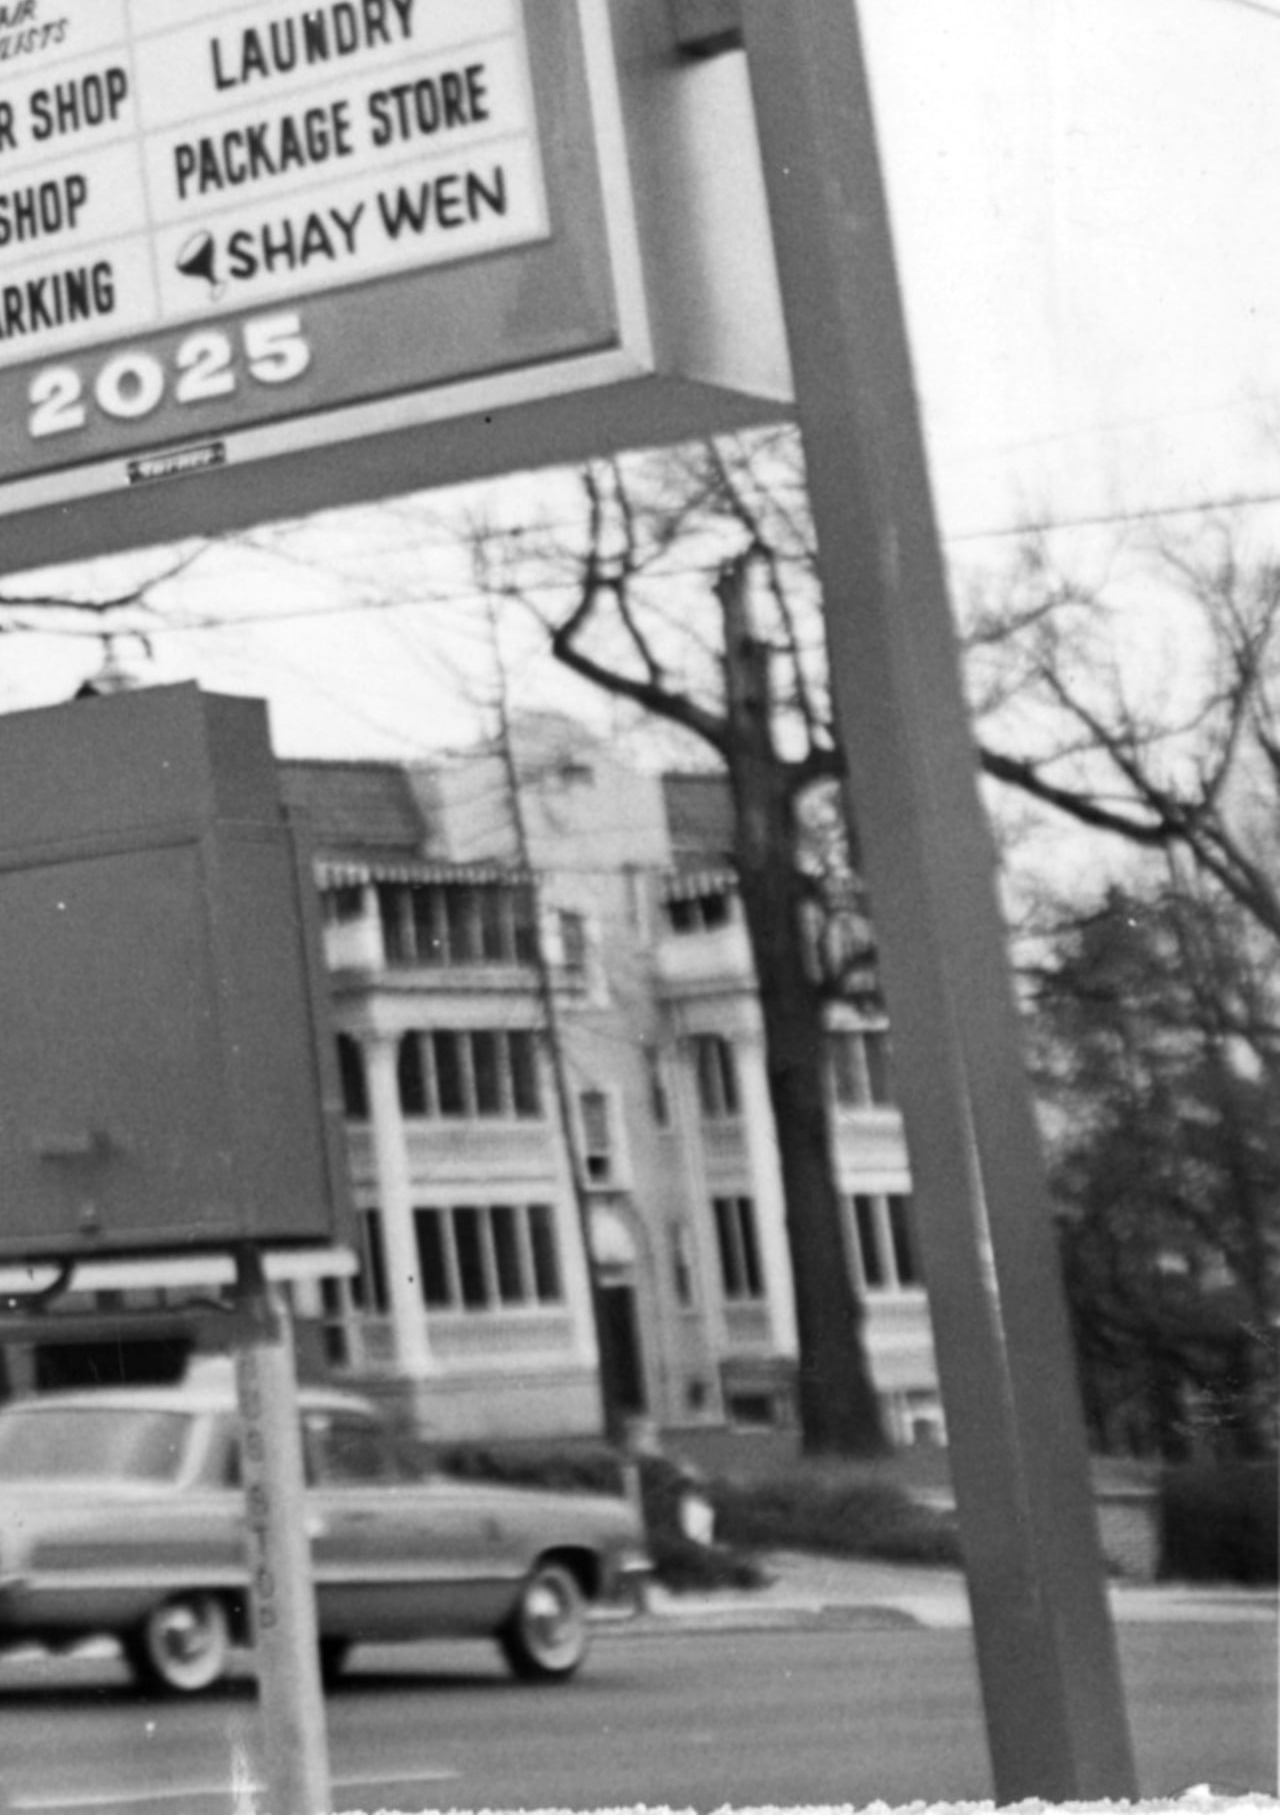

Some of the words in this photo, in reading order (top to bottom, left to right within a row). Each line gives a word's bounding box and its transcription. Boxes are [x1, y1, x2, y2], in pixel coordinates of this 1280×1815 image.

[31, 66, 129, 141] SHOP
[174, 100, 352, 198] PACKAGE
[369, 63, 489, 148] STORE
[227, 202, 366, 281] SHAY
[377, 165, 508, 240] WEN
[28, 313, 311, 438] 2025
